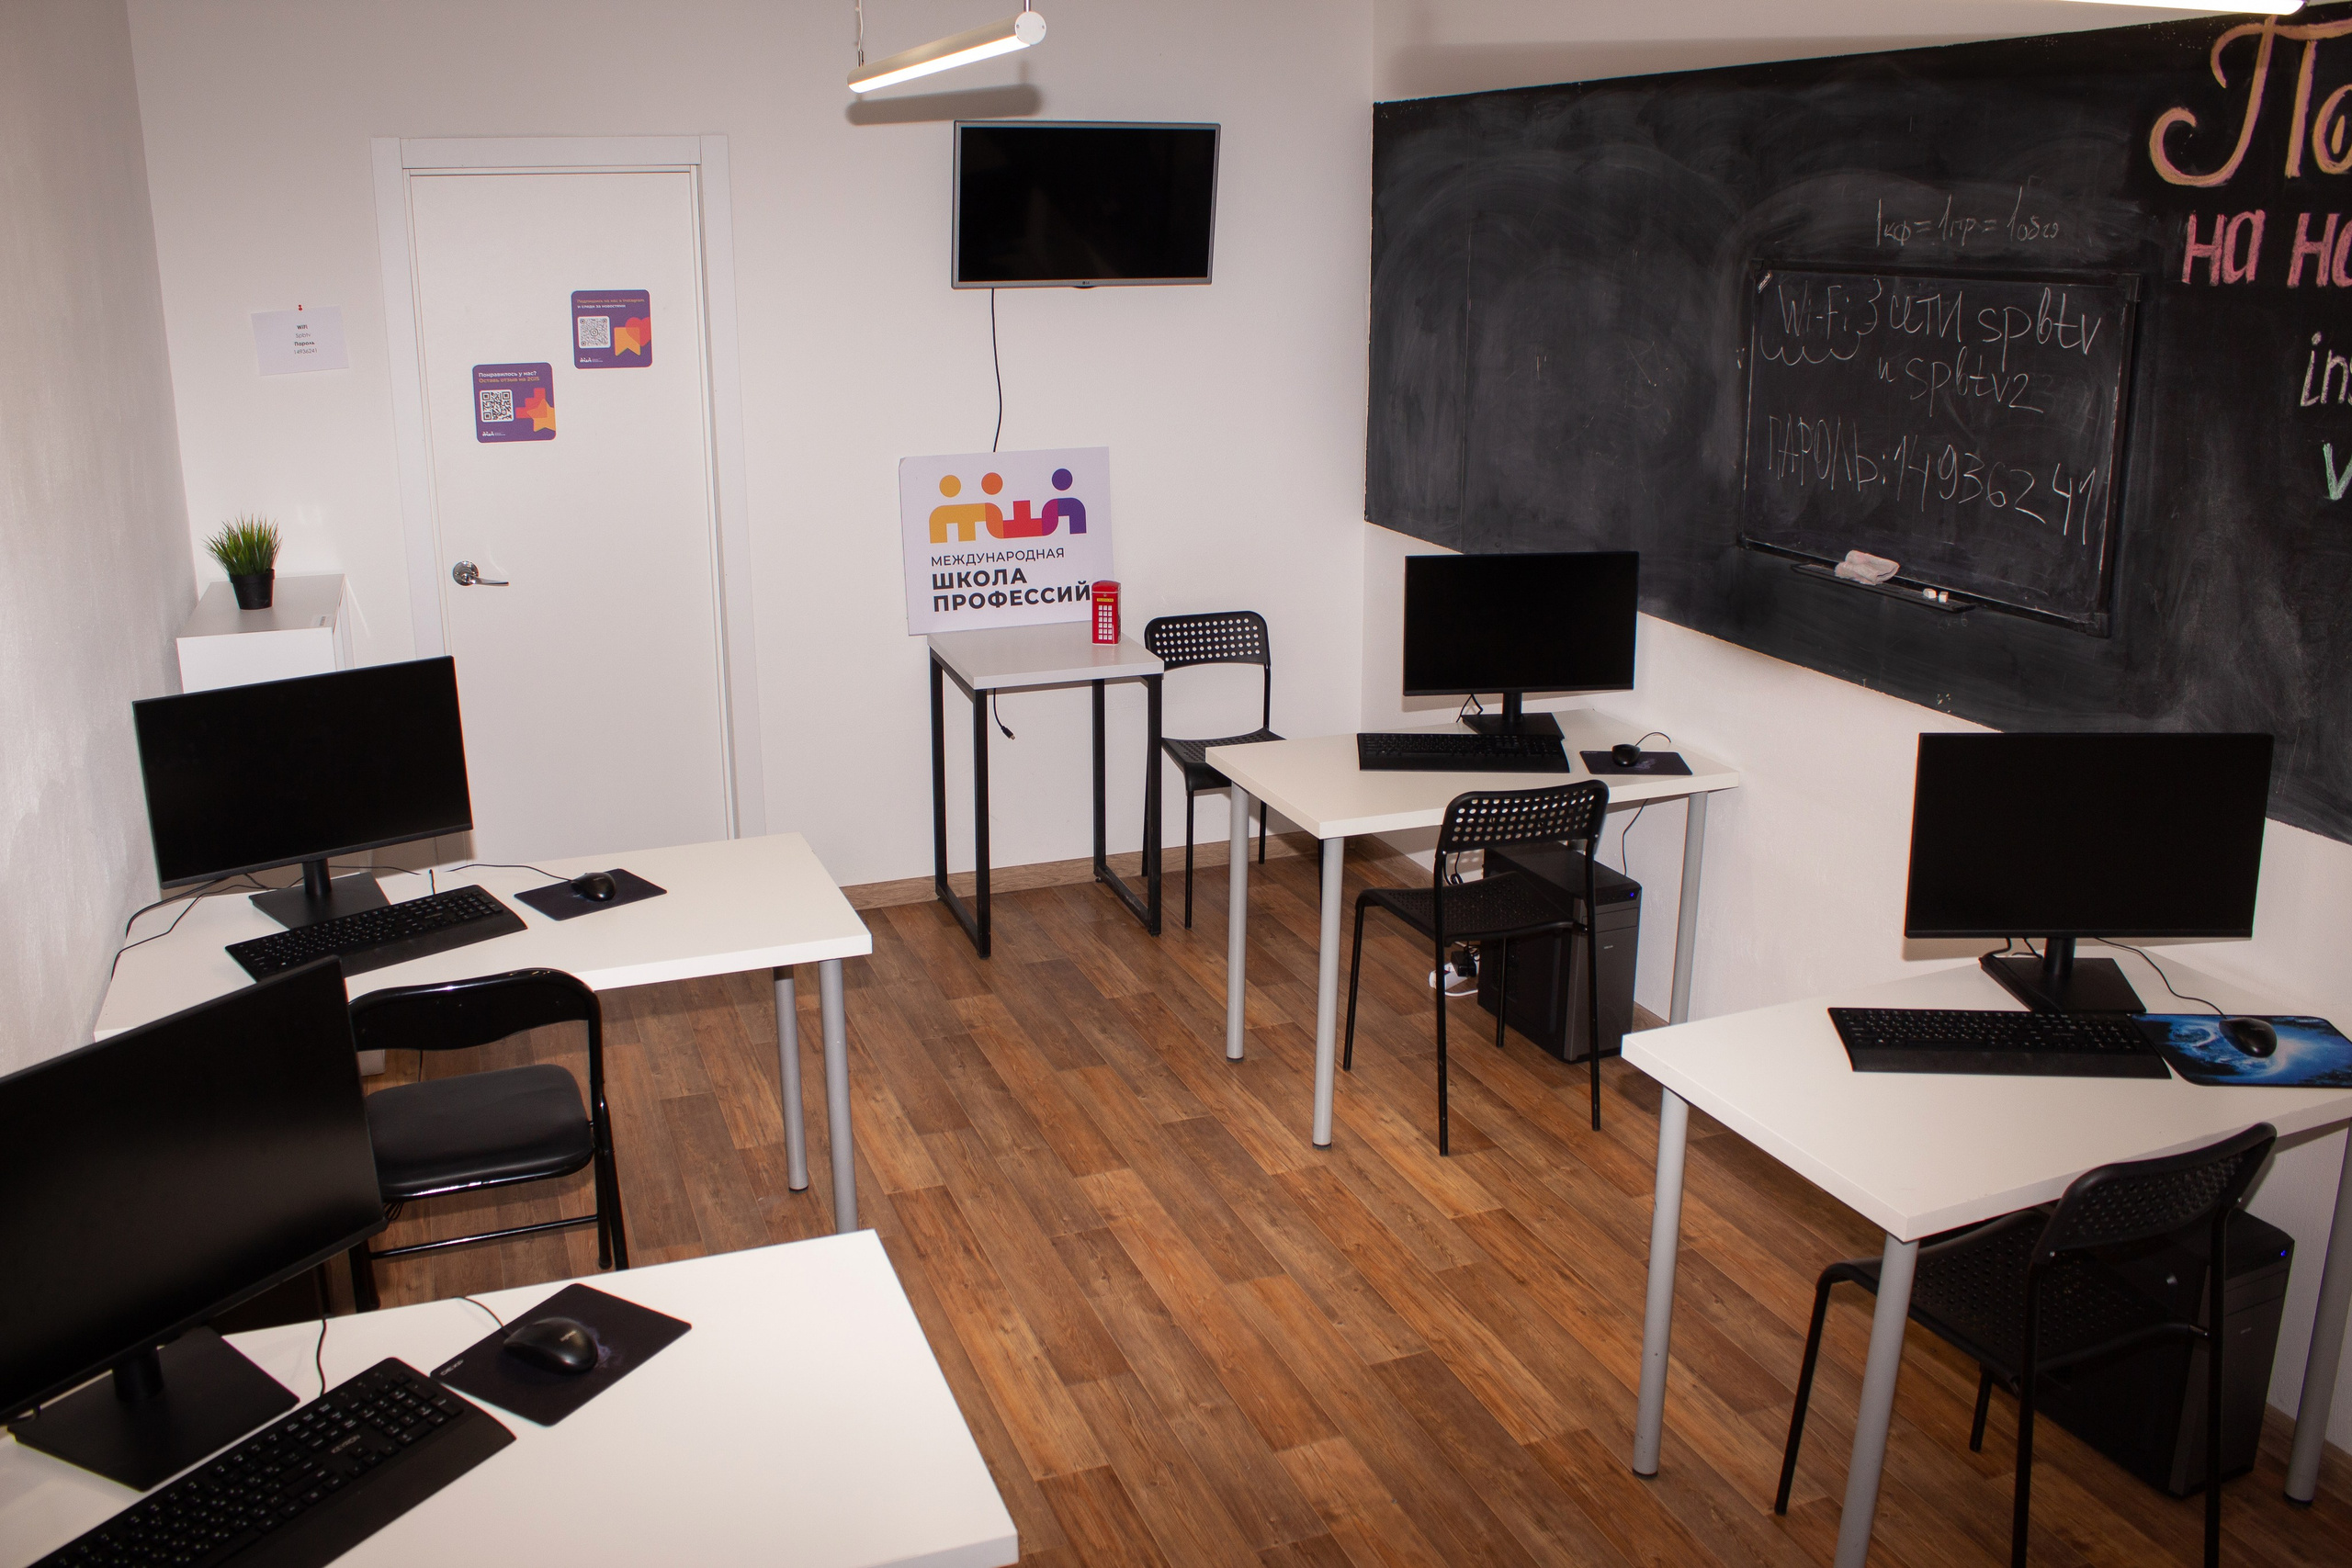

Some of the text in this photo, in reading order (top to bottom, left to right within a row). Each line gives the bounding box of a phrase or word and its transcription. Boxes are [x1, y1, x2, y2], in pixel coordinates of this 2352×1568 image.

[931, 547, 1065, 567] МЕЖДУНАРОДНАЯ
[932, 567, 1027, 590] ШКОЛА
[933, 580, 1091, 613] ПРОФЕССИЙ
